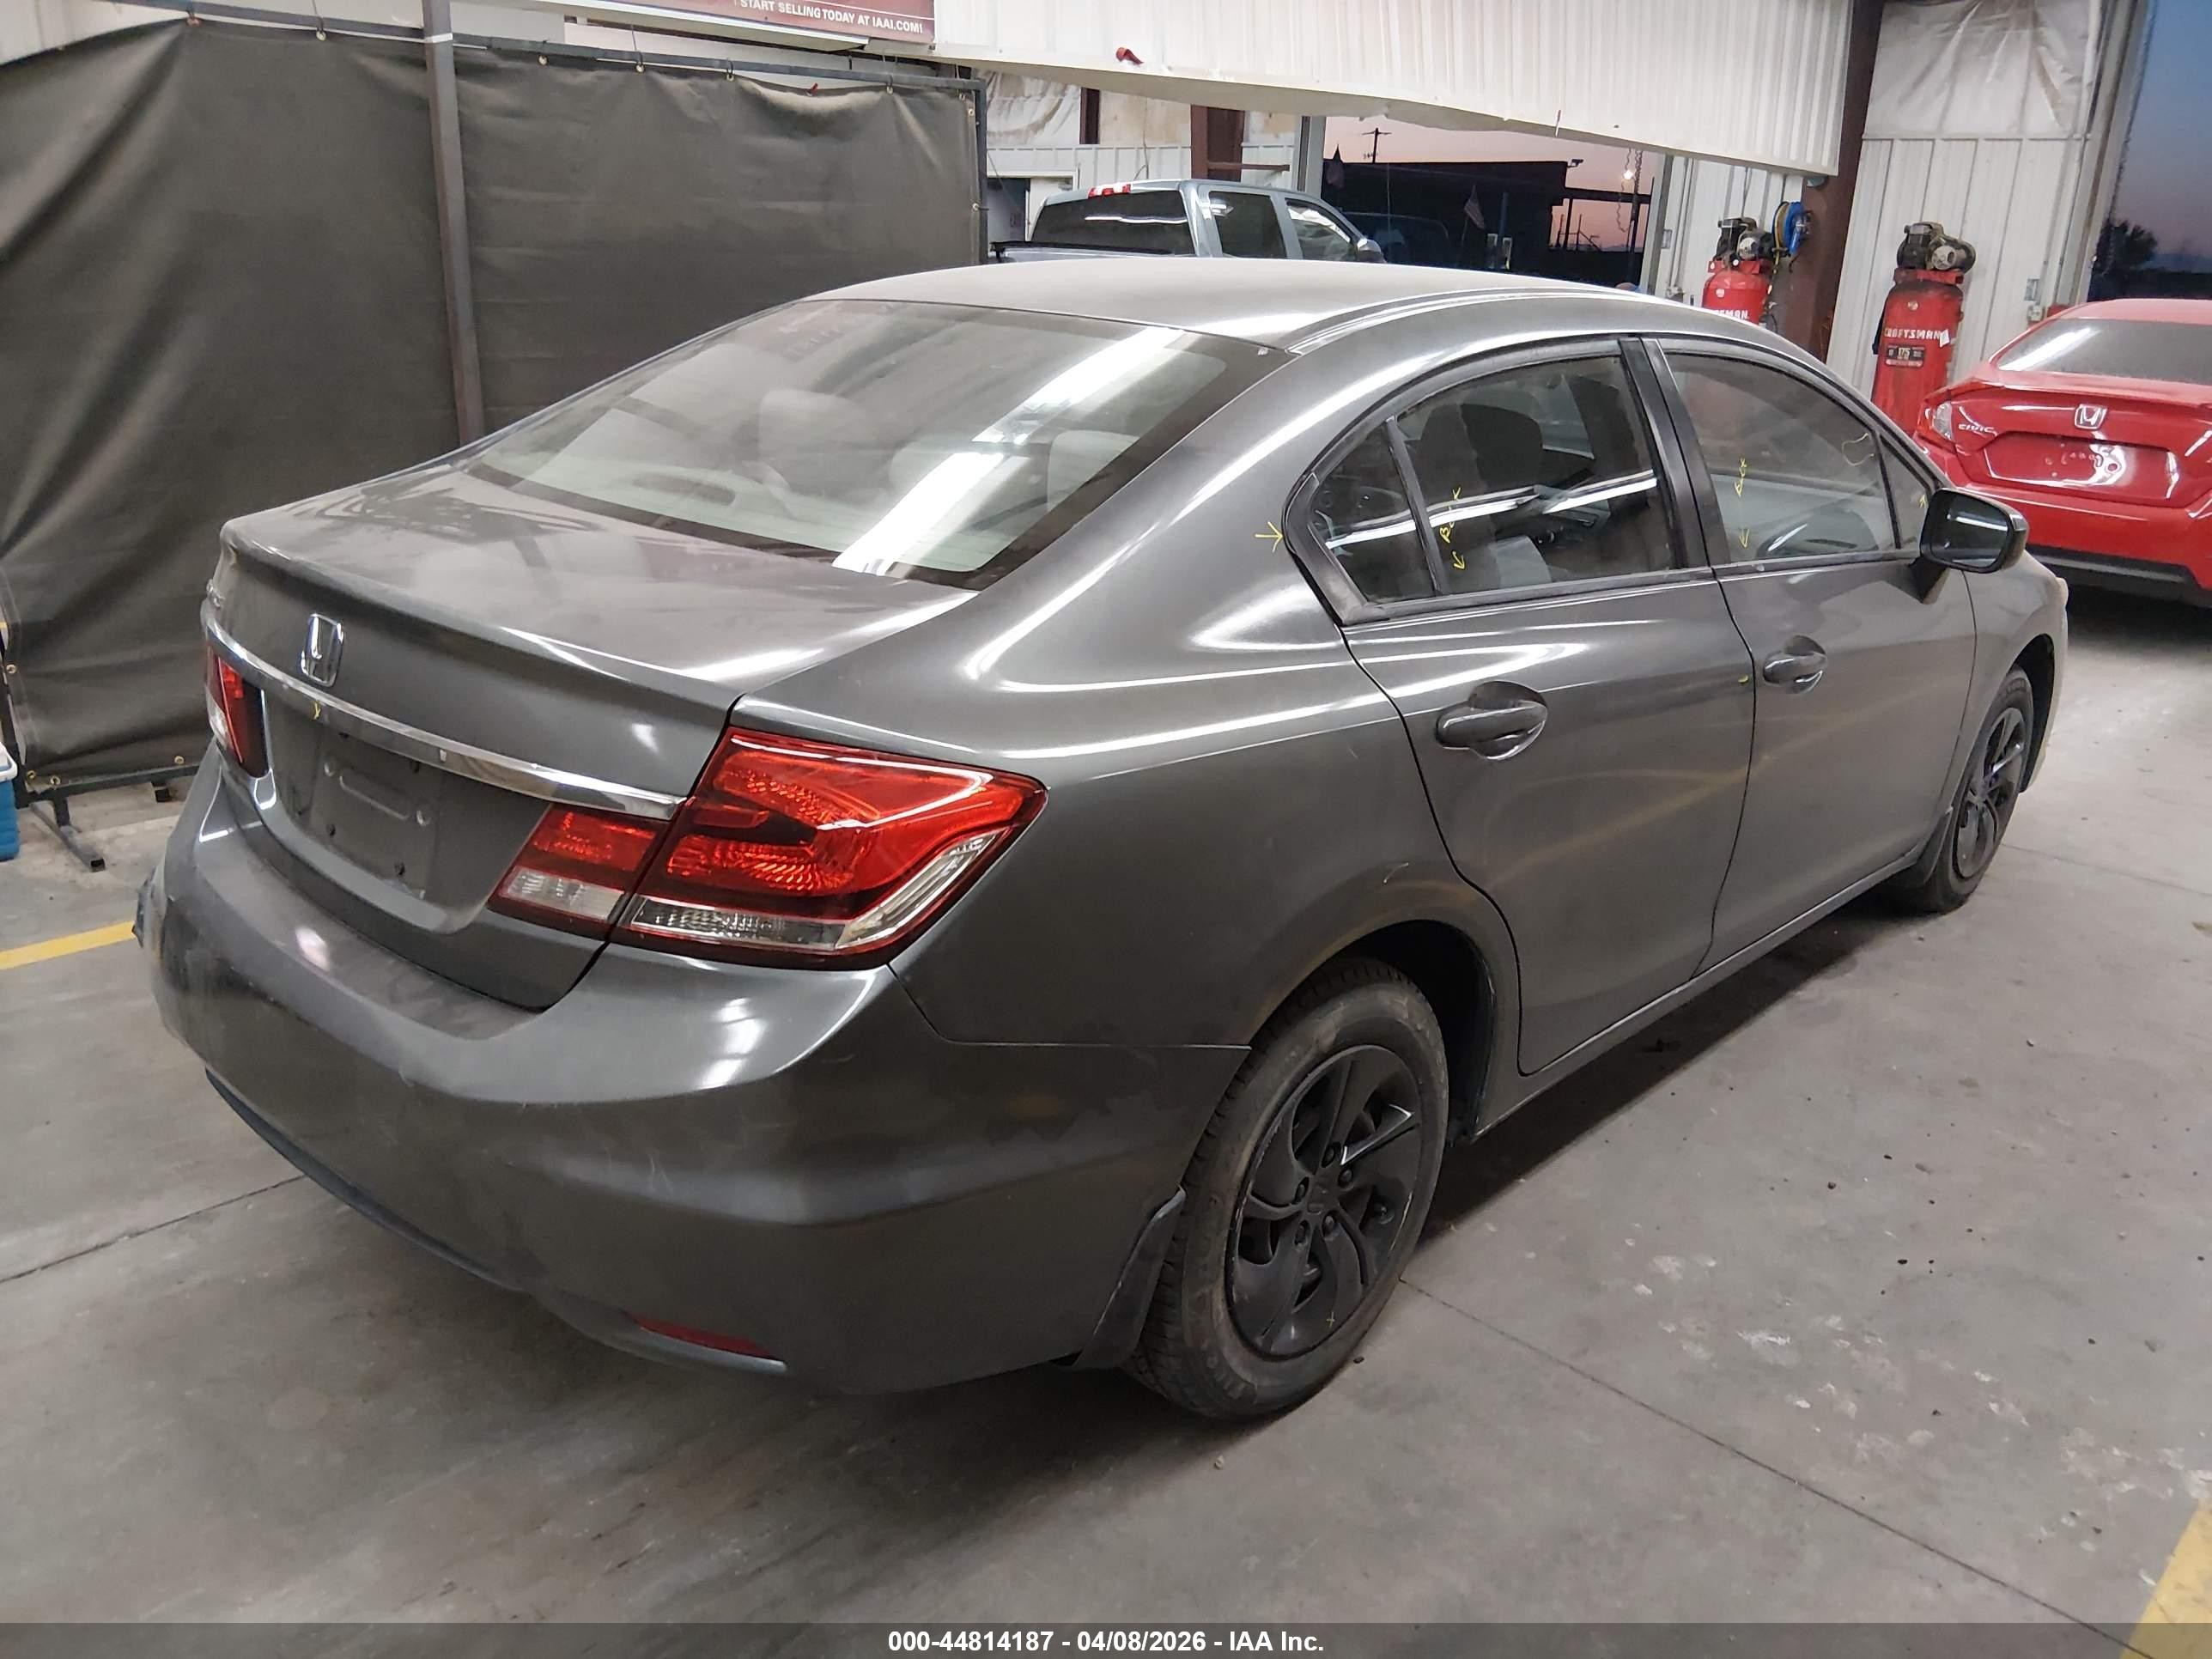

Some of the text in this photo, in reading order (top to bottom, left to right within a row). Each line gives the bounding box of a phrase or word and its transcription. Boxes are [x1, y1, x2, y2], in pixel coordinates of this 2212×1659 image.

[740, 0, 924, 33] START SELLING TODAY AT IAAI.COM!
[1958, 423, 1995, 433] CIVIC
